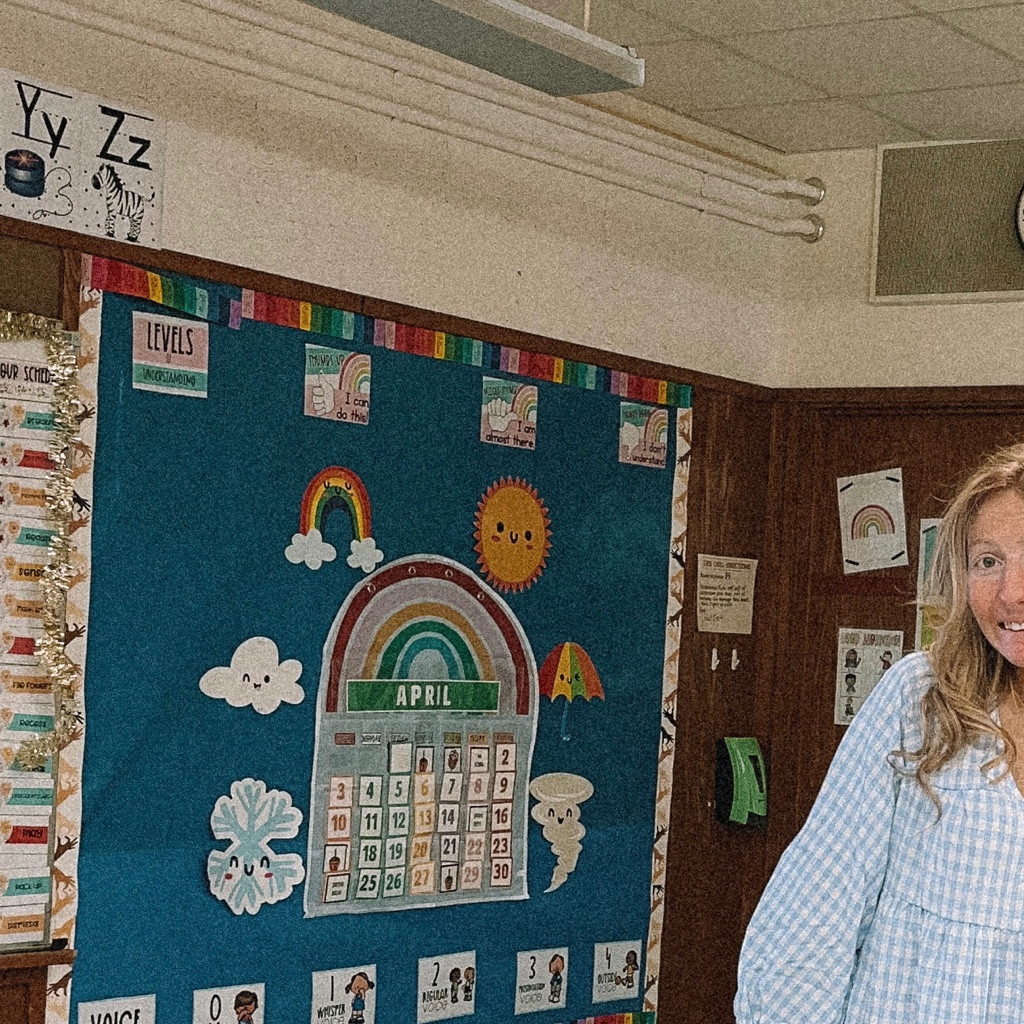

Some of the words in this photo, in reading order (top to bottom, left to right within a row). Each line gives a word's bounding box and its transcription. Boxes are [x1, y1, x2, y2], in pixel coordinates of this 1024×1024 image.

[147, 321, 194, 356] LEVELS
[345, 392, 351, 405] I
[353, 398, 369, 408] can
[336, 406, 348, 420] do
[395, 684, 451, 706] APRIL
[501, 749, 509, 766] 2
[336, 782, 345, 800] 3
[366, 781, 374, 799] 4
[394, 780, 403, 798] 5
[421, 779, 429, 796] 6
[449, 778, 456, 795] 7
[474, 778, 482, 794] 8
[500, 777, 508, 793] 9
[331, 813, 347, 832] 10
[365, 812, 378, 831] 11
[392, 811, 406, 829] 12
[419, 809, 432, 826] 13
[441, 808, 455, 826] 14
[494, 807, 508, 825] 16
[362, 844, 377, 862] 18
[388, 842, 403, 860] 19
[413, 842, 427, 859] 20
[443, 837, 456, 855] 21
[467, 838, 483, 856] 22
[493, 837, 508, 854] 23
[414, 869, 429, 887] 27
[463, 866, 479, 883] 29
[493, 863, 509, 880] 30
[359, 874, 377, 892] 25
[385, 873, 402, 891] 26
[528, 955, 537, 980] 3
[605, 947, 612, 970] 4
[431, 961, 440, 987] 2
[421, 987, 449, 1004] REGULAR
[316, 1003, 346, 1020] WHISPER
